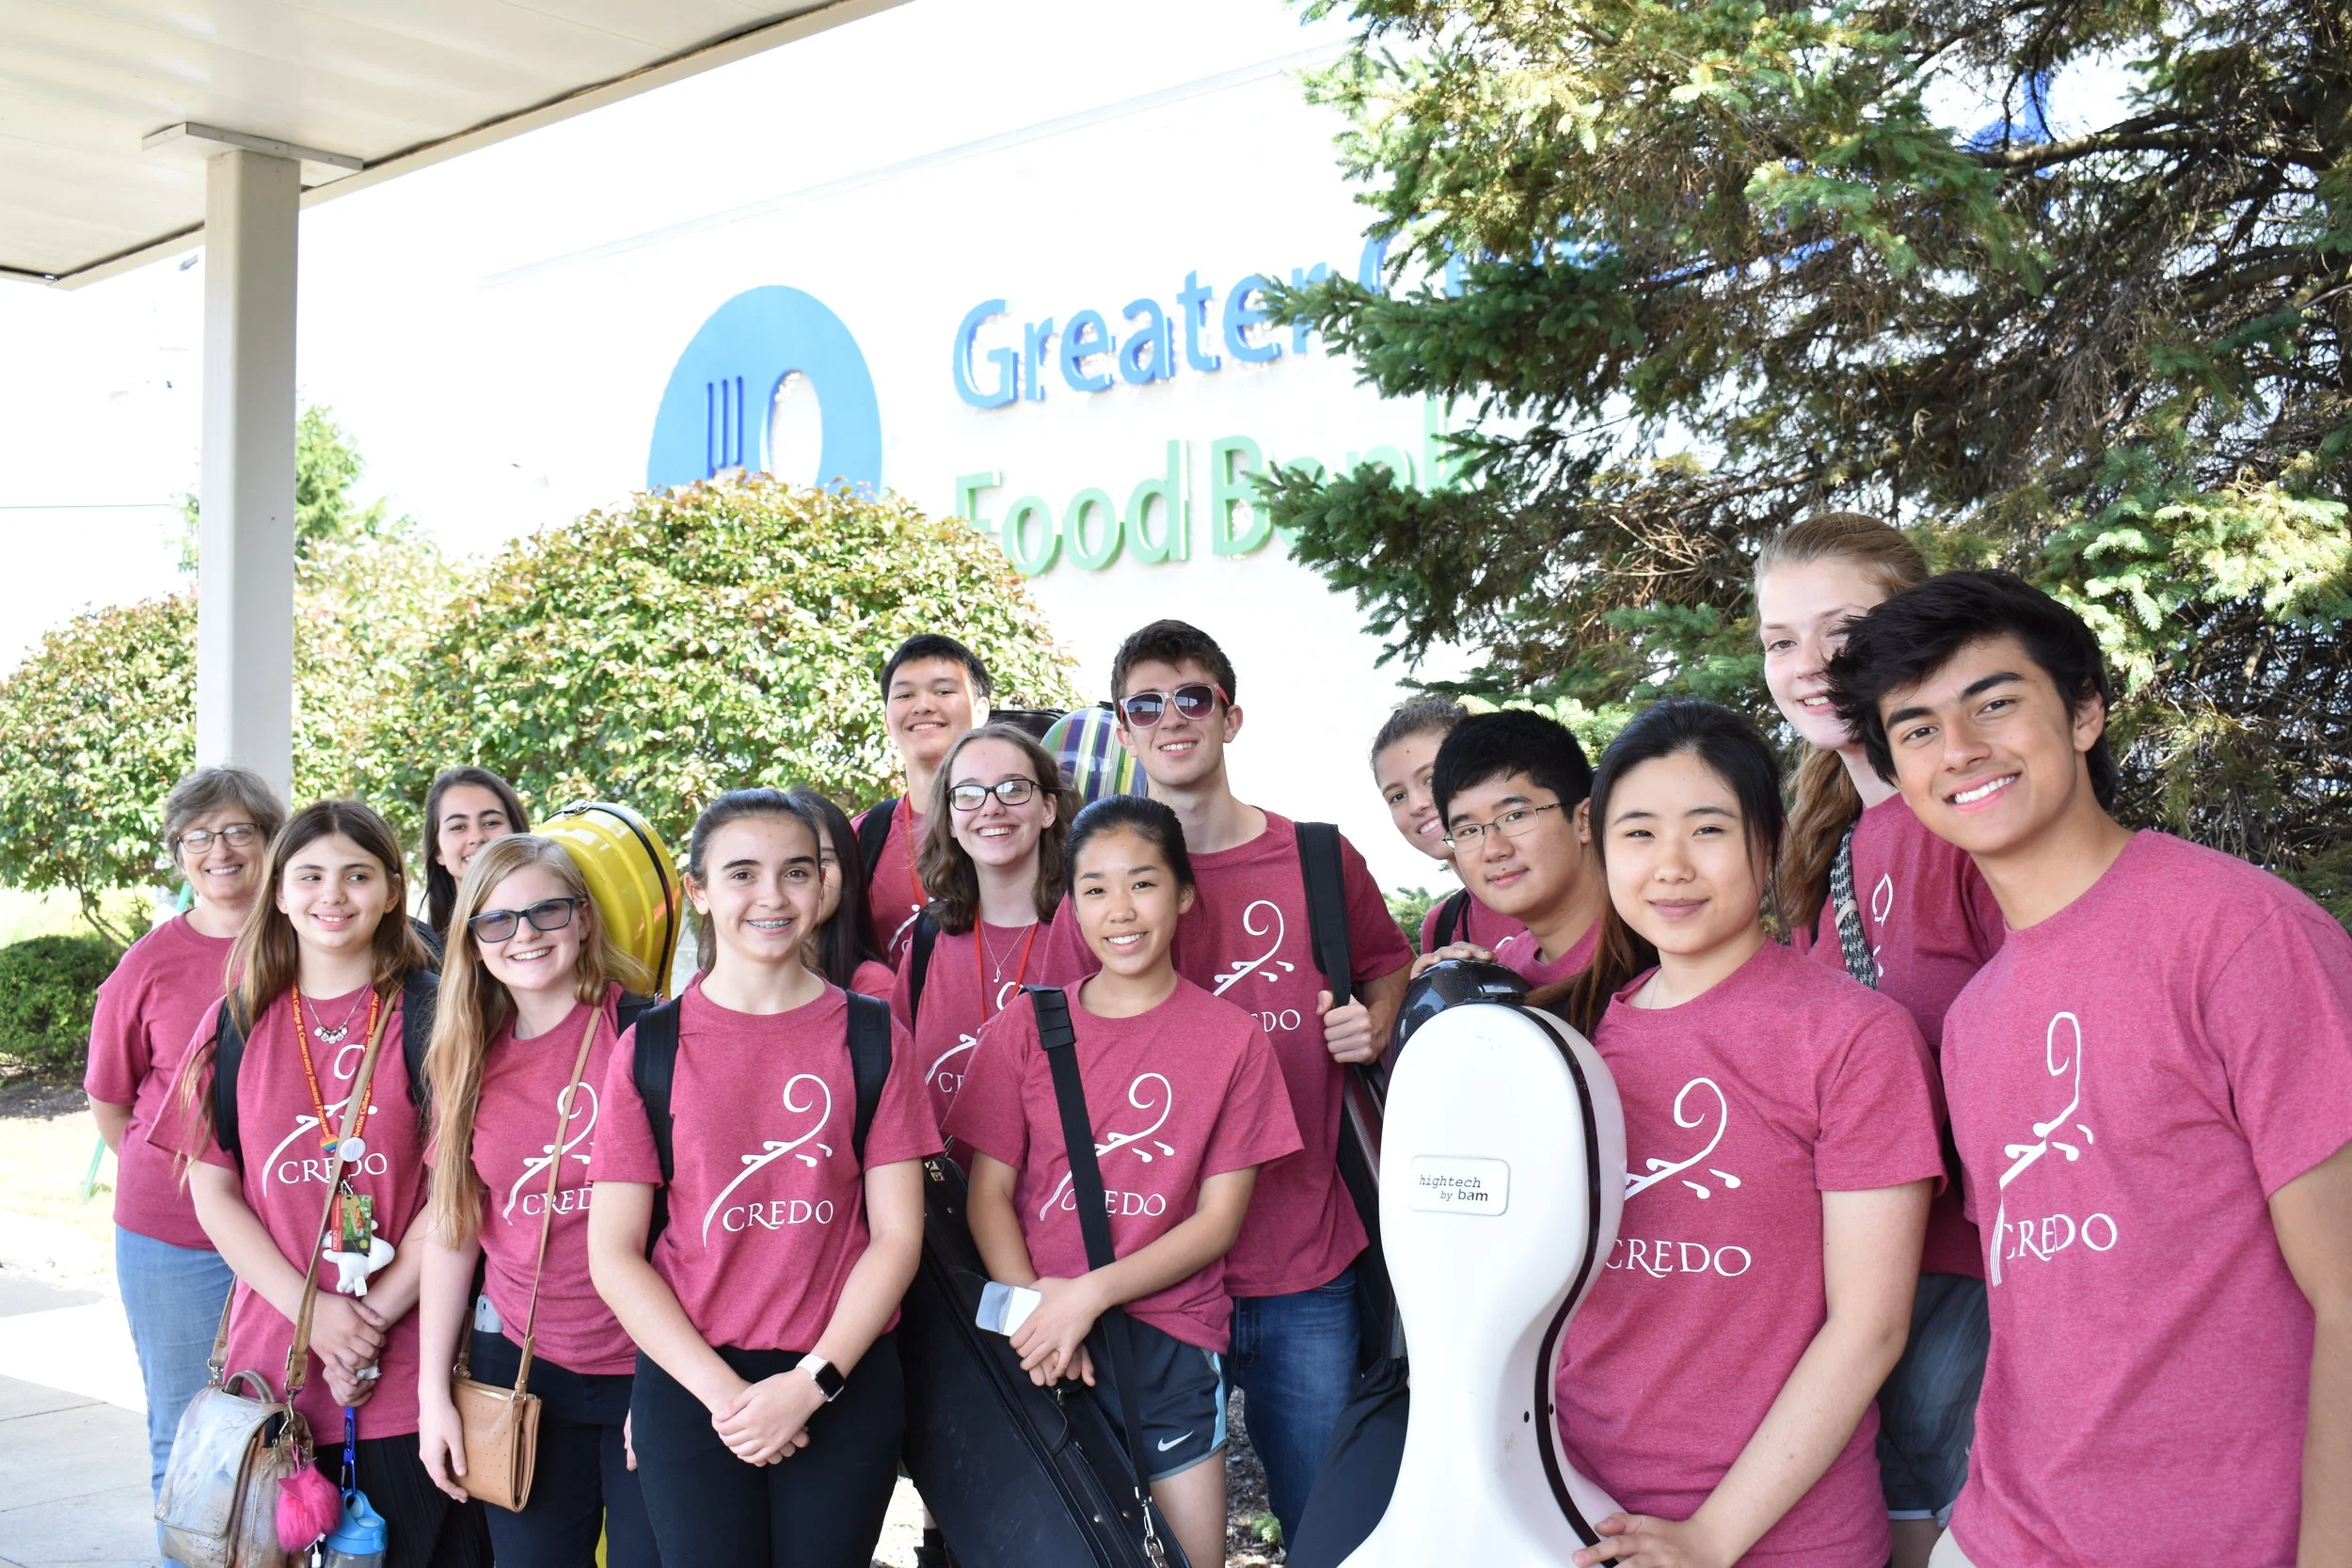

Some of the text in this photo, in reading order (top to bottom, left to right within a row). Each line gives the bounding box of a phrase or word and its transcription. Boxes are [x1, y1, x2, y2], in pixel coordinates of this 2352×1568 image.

[952, 261, 1327, 408] Greater
[955, 438, 1191, 578] Food
[309, 1075, 322, 1105] Summer
[1419, 1174, 1481, 1189] hightech
[1439, 1188, 1488, 1202] by bam
[522, 1187, 593, 1215] CRED
[722, 1199, 834, 1232] CREDO
[1060, 1188, 1167, 1218] CEDO
[1605, 1238, 1752, 1278] CREDO
